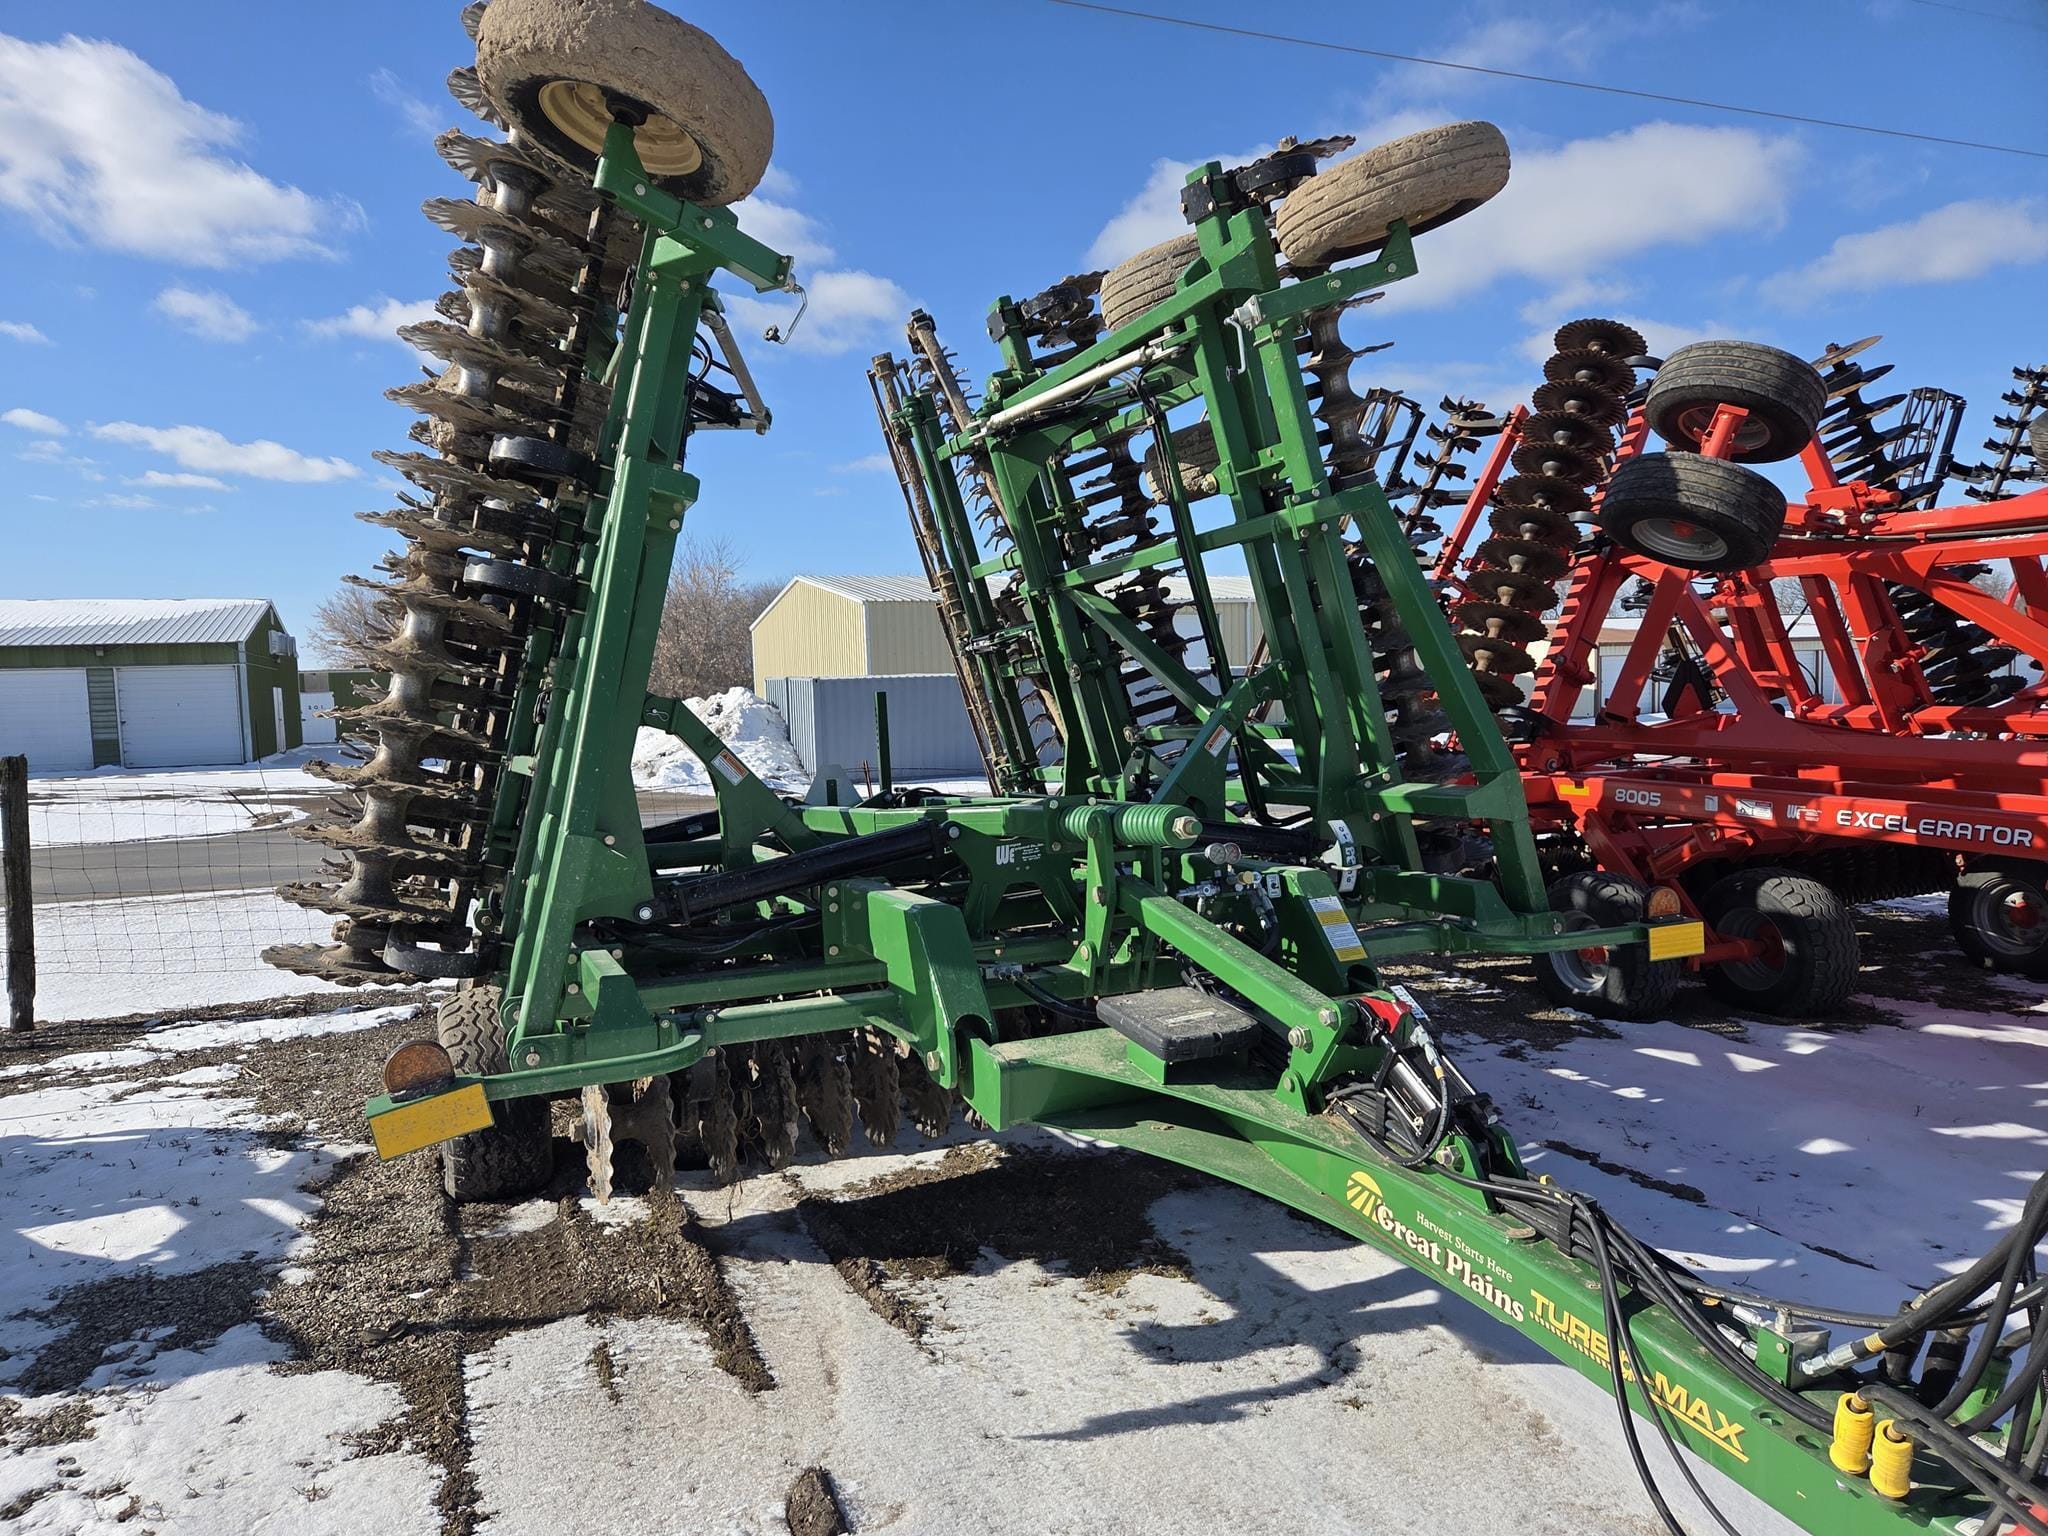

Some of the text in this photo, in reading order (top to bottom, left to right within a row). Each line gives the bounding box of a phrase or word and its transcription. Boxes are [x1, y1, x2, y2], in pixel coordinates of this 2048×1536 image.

[1615, 788, 1662, 807] 8005
[1836, 808, 2034, 849] EXCELERATOR
[1376, 1204, 1524, 1323] Great Plains
[1416, 1210, 1513, 1283] Harvest Starts Here
